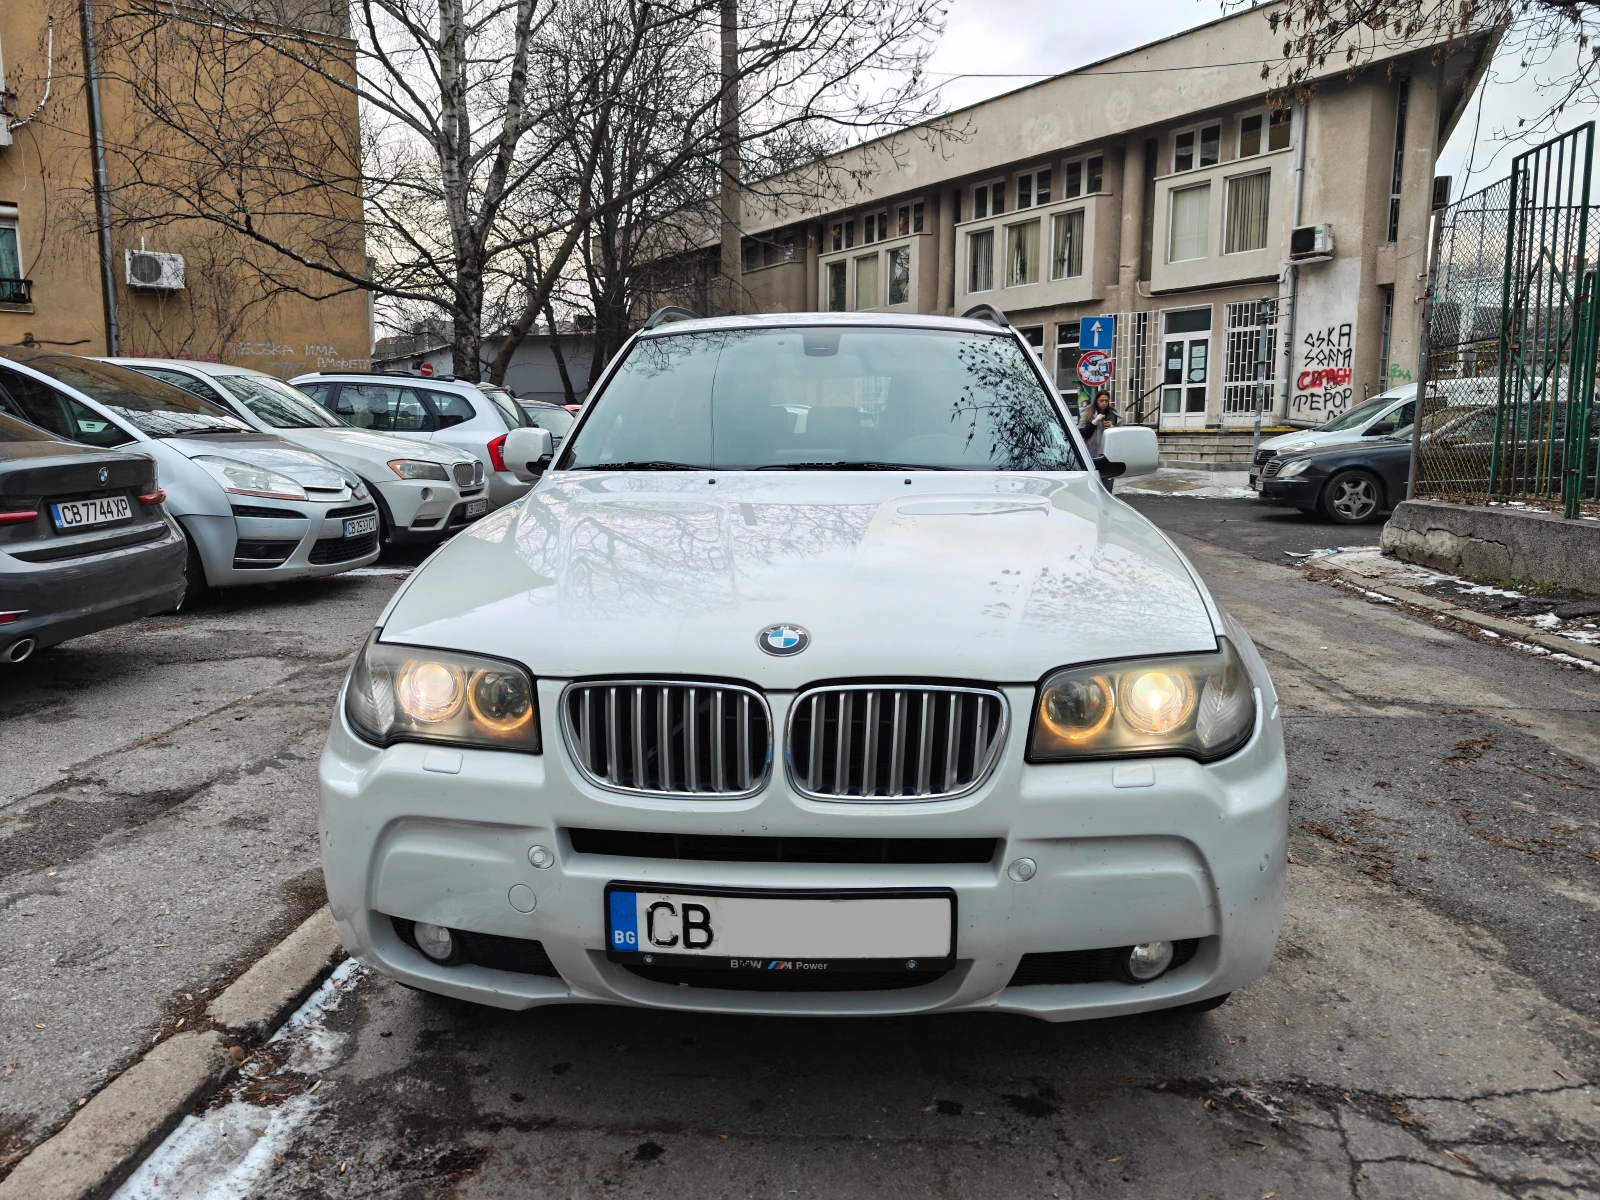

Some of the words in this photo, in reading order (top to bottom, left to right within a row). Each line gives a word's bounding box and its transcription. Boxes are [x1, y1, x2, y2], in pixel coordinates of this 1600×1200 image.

[305, 345, 338, 356] ИМА
[82, 501, 114, 522] 7744
[646, 901, 714, 950] CB
[614, 930, 636, 944] BG
[730, 959, 762, 969] BMW
[795, 961, 828, 970] Power
